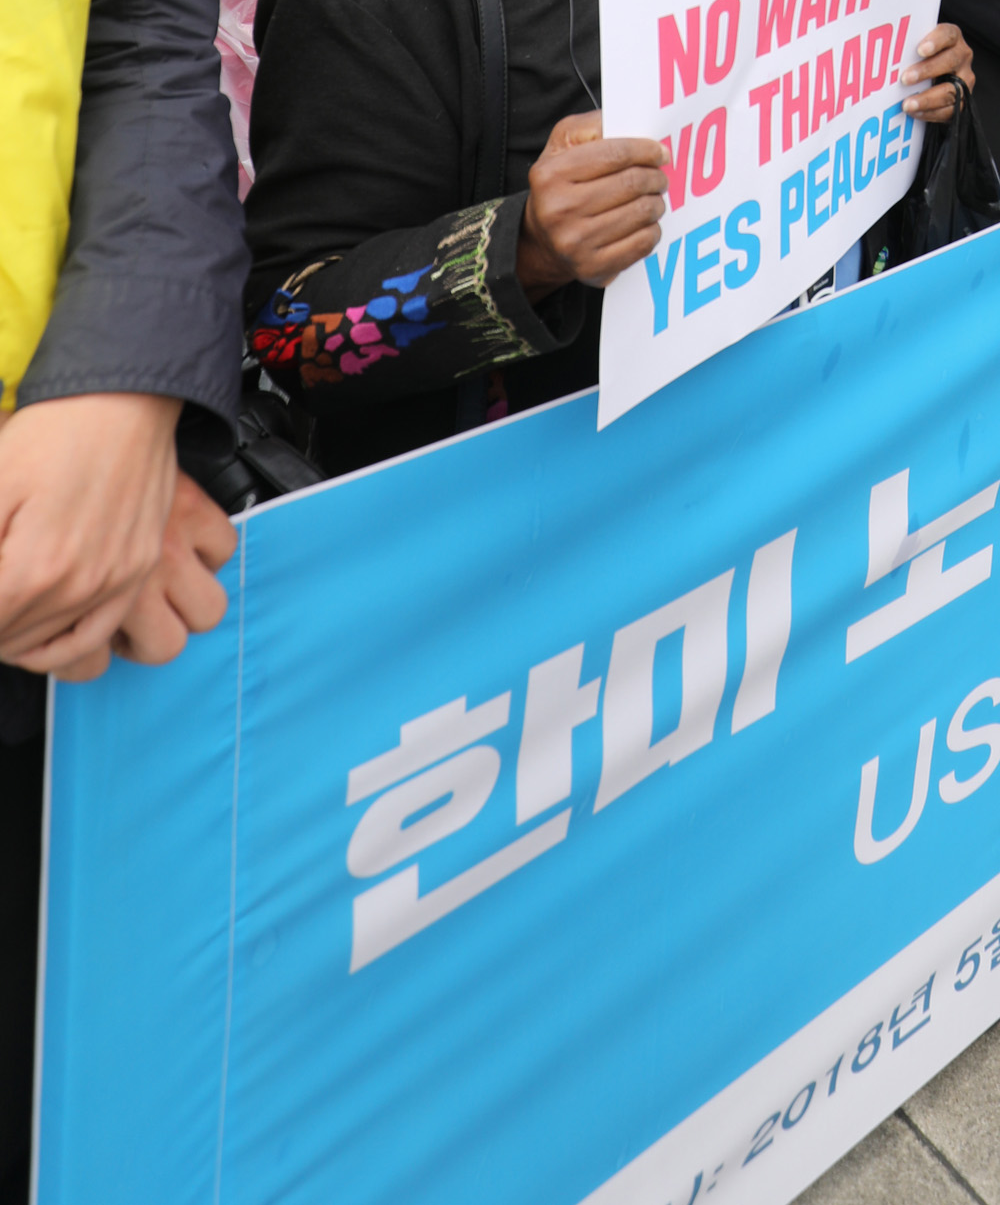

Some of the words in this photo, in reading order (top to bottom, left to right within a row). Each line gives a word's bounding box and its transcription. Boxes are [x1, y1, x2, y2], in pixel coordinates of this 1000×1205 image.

[644, 198, 761, 337] YES
[779, 91, 918, 260] PEACE!
[662, 105, 727, 213] NO
[749, 14, 911, 167] THAAD!
[346, 526, 797, 975] 한미
[741, 971, 937, 1169] 2018년
